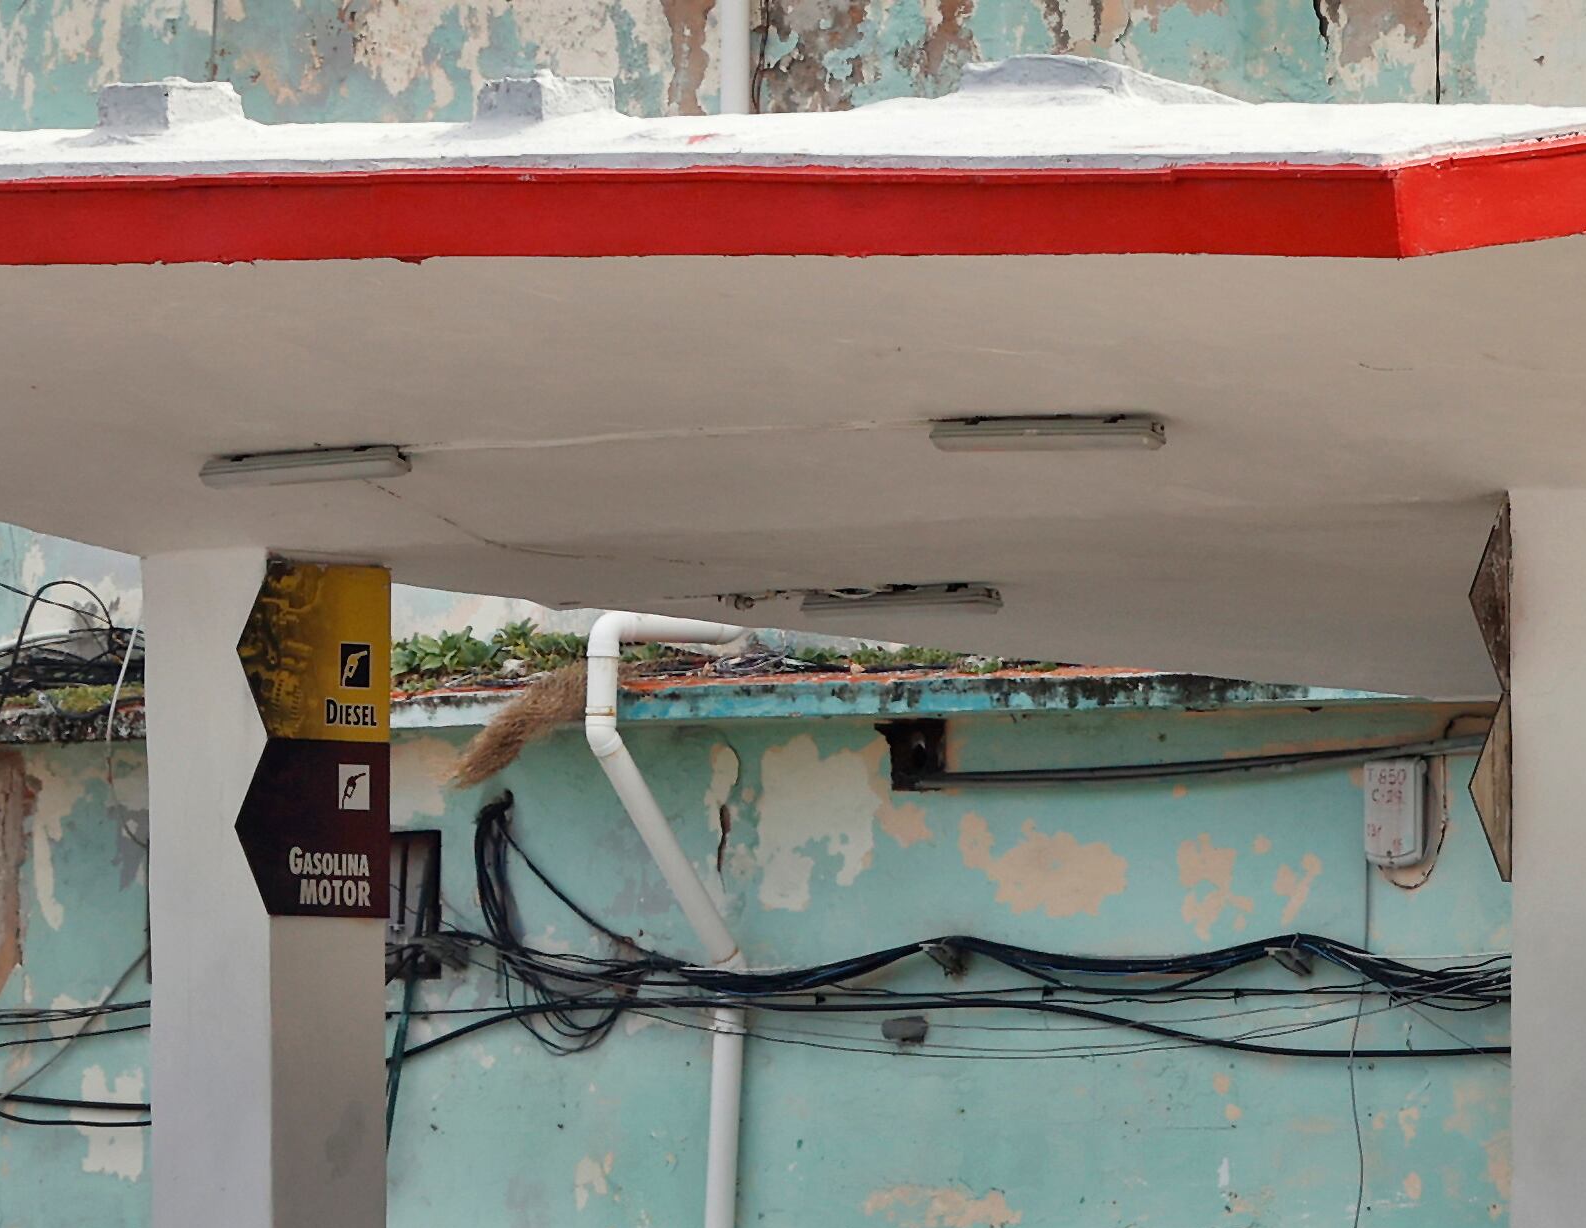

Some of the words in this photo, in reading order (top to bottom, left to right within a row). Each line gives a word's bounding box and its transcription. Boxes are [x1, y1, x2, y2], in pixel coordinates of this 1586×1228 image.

[326, 698, 377, 727] DIESEL
[289, 846, 370, 877] GASOLINA
[299, 879, 371, 907] MOTOR
